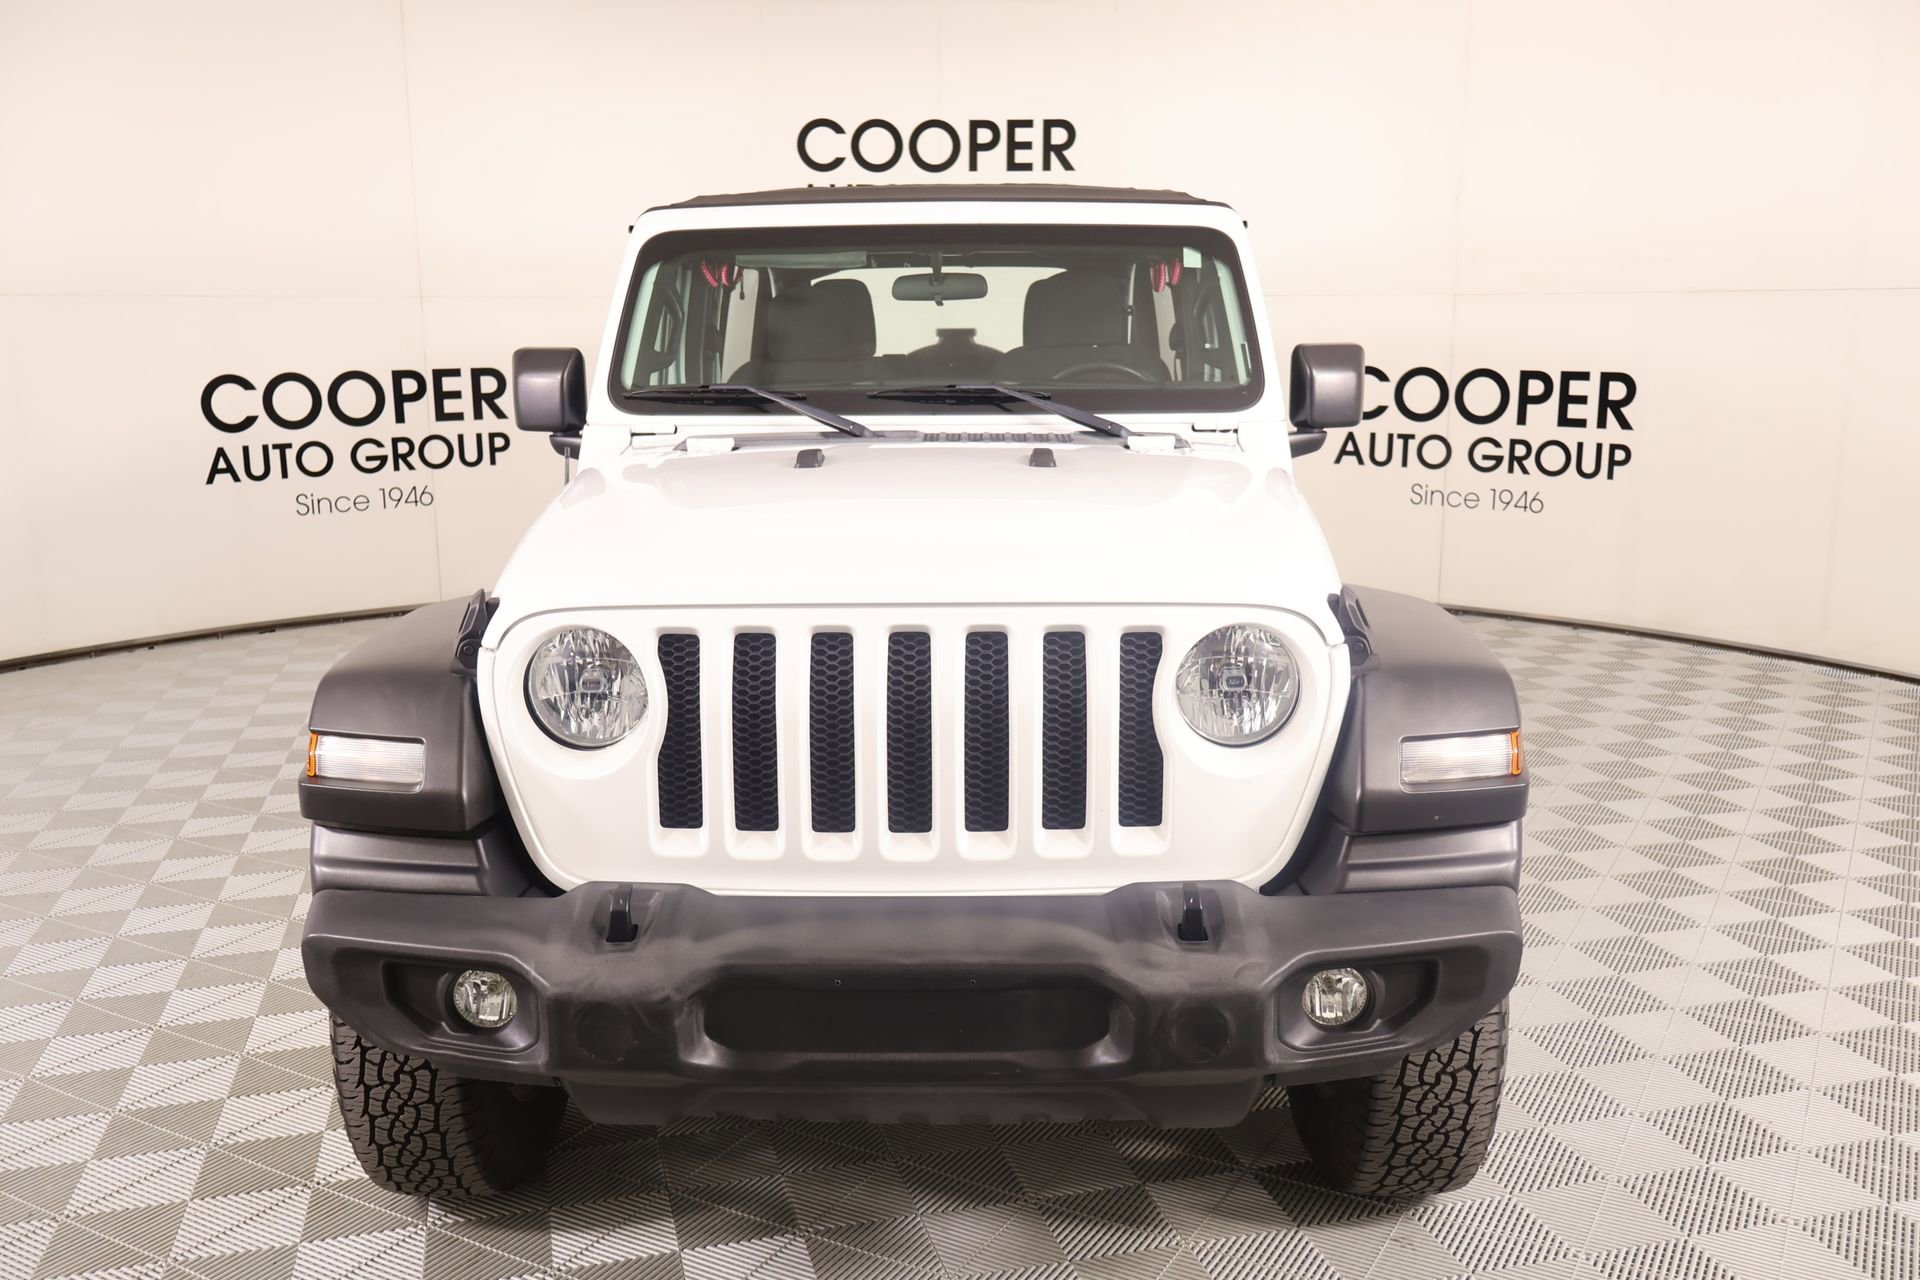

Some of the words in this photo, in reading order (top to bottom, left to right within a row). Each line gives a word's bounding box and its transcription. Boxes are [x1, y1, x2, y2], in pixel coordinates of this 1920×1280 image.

[796, 118, 1076, 173] COOPER
[201, 367, 509, 433] COOPER
[206, 440, 334, 485] AUTO
[350, 432, 511, 474] GROUP
[1334, 432, 1453, 470] AUTO
[1468, 436, 1631, 481] GROUP
[296, 493, 371, 517] Since
[378, 486, 434, 510] 1946
[1410, 482, 1480, 510] Since
[1488, 489, 1544, 514] 1946
